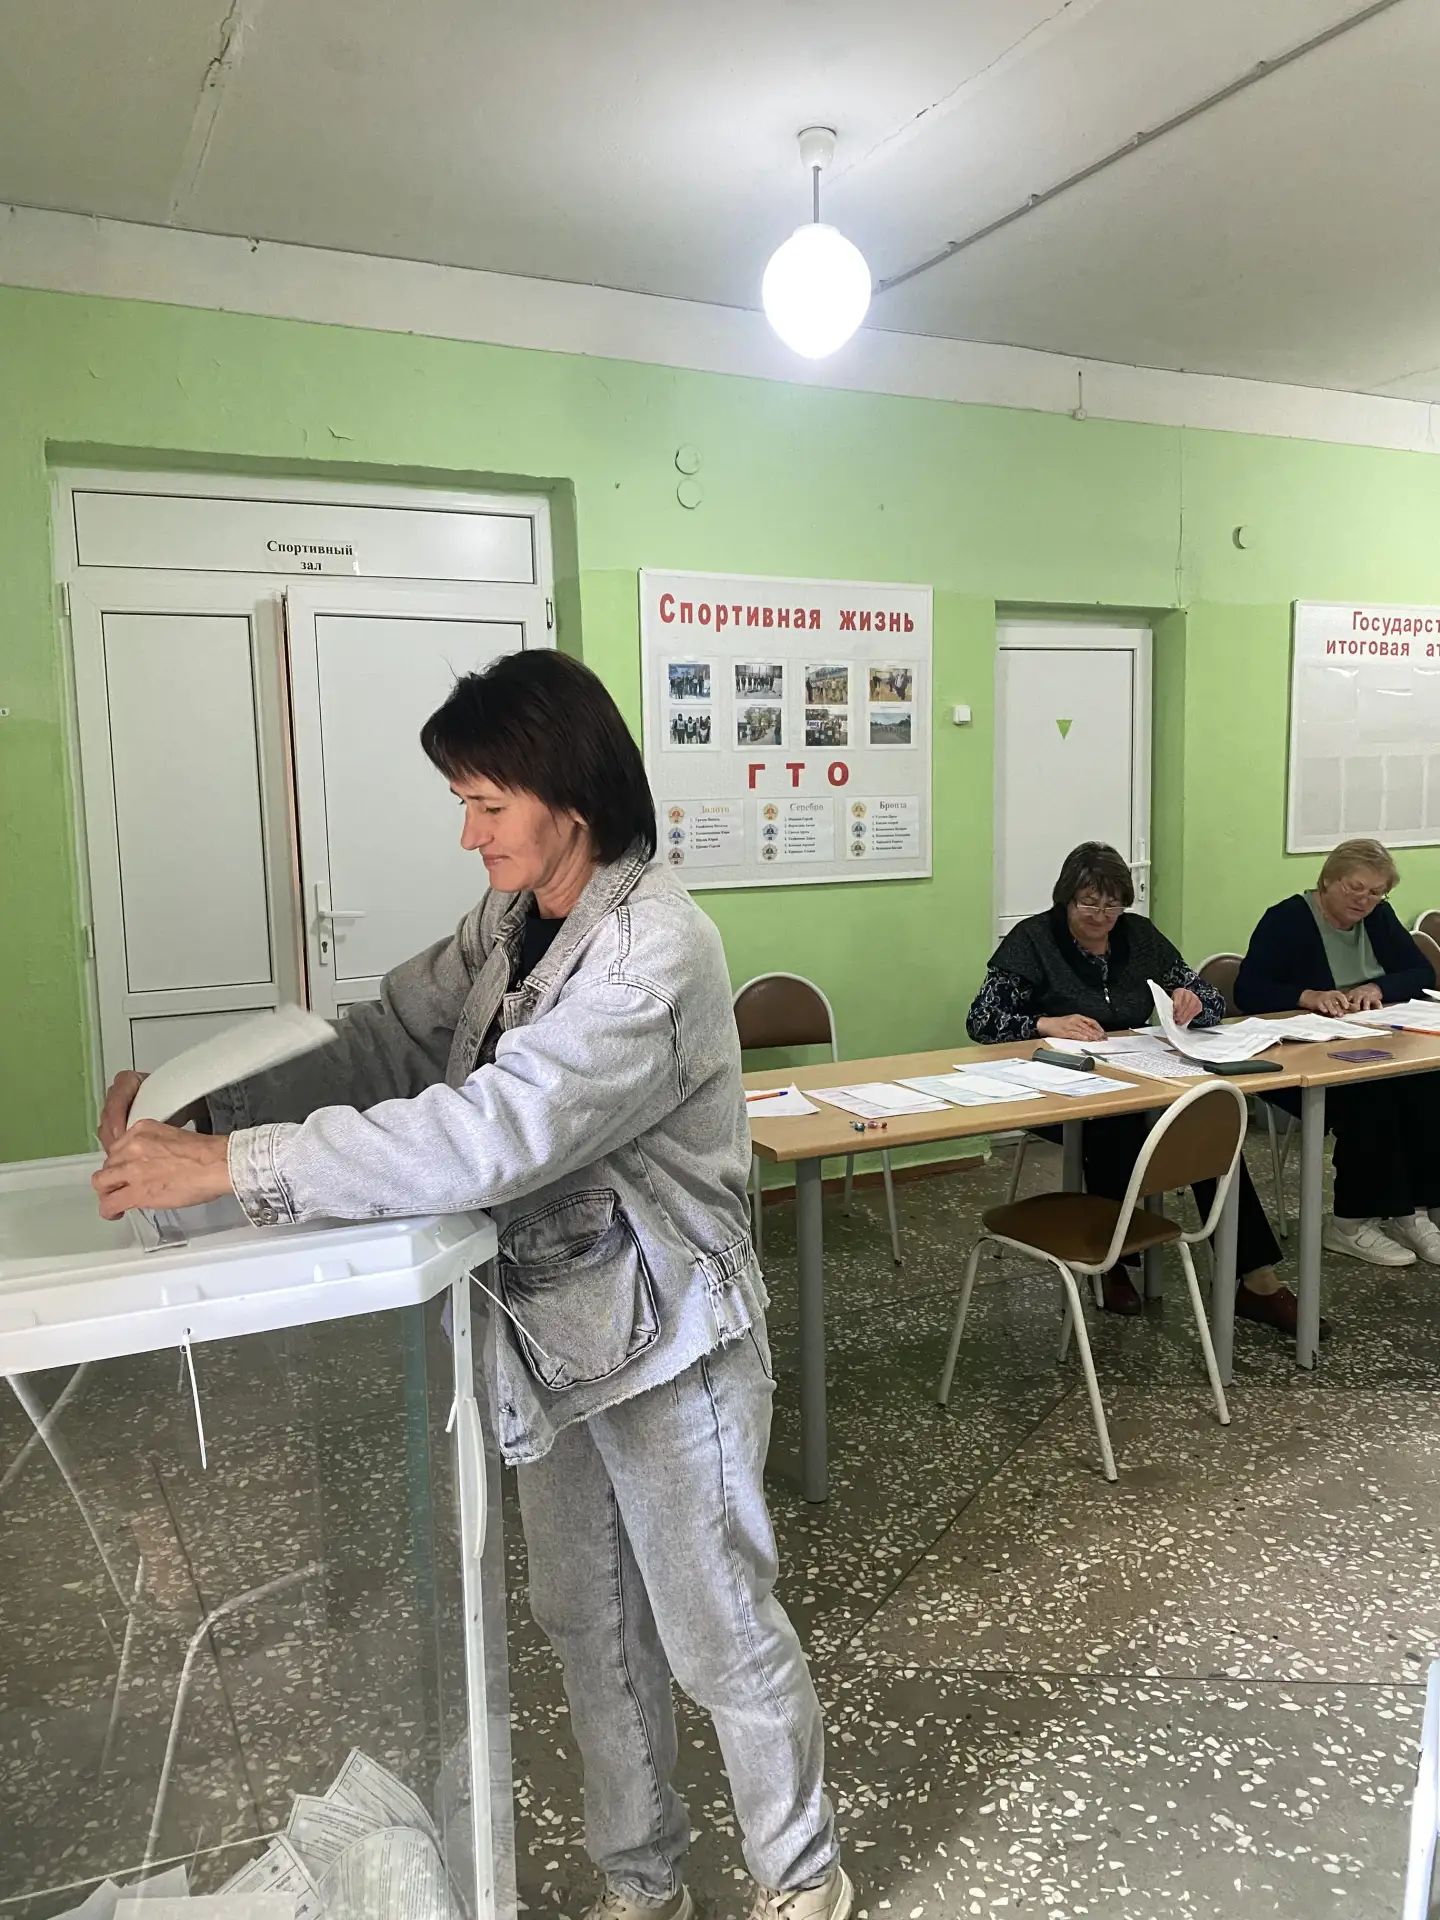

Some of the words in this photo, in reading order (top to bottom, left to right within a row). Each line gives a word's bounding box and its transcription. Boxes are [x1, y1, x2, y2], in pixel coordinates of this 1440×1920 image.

[267, 540, 353, 556] Спортивный
[300, 561, 322, 571] зал
[659, 593, 821, 632] Спортивная
[839, 609, 915, 633] жизнь
[1326, 639, 1410, 657] итоговая
[748, 761, 849, 789] ГТО
